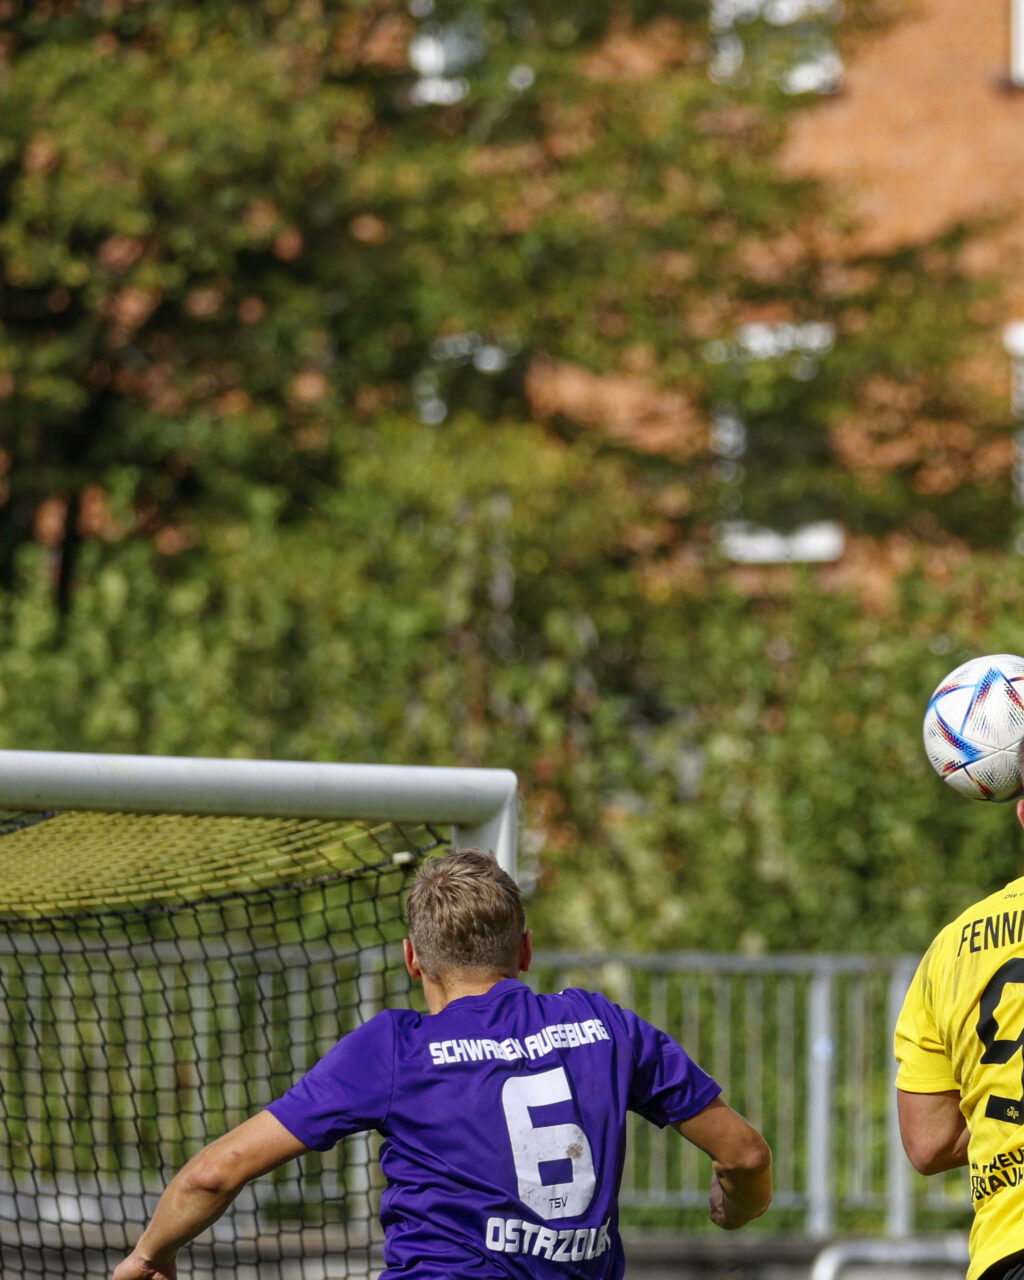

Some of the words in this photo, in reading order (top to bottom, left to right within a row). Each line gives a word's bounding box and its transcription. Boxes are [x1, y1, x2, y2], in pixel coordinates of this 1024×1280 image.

[428, 1037, 528, 1065] SCHWABEN
[524, 1018, 611, 1060] AUGSBURG
[502, 1066, 596, 1220] 6
[548, 1195, 568, 1210] TSV
